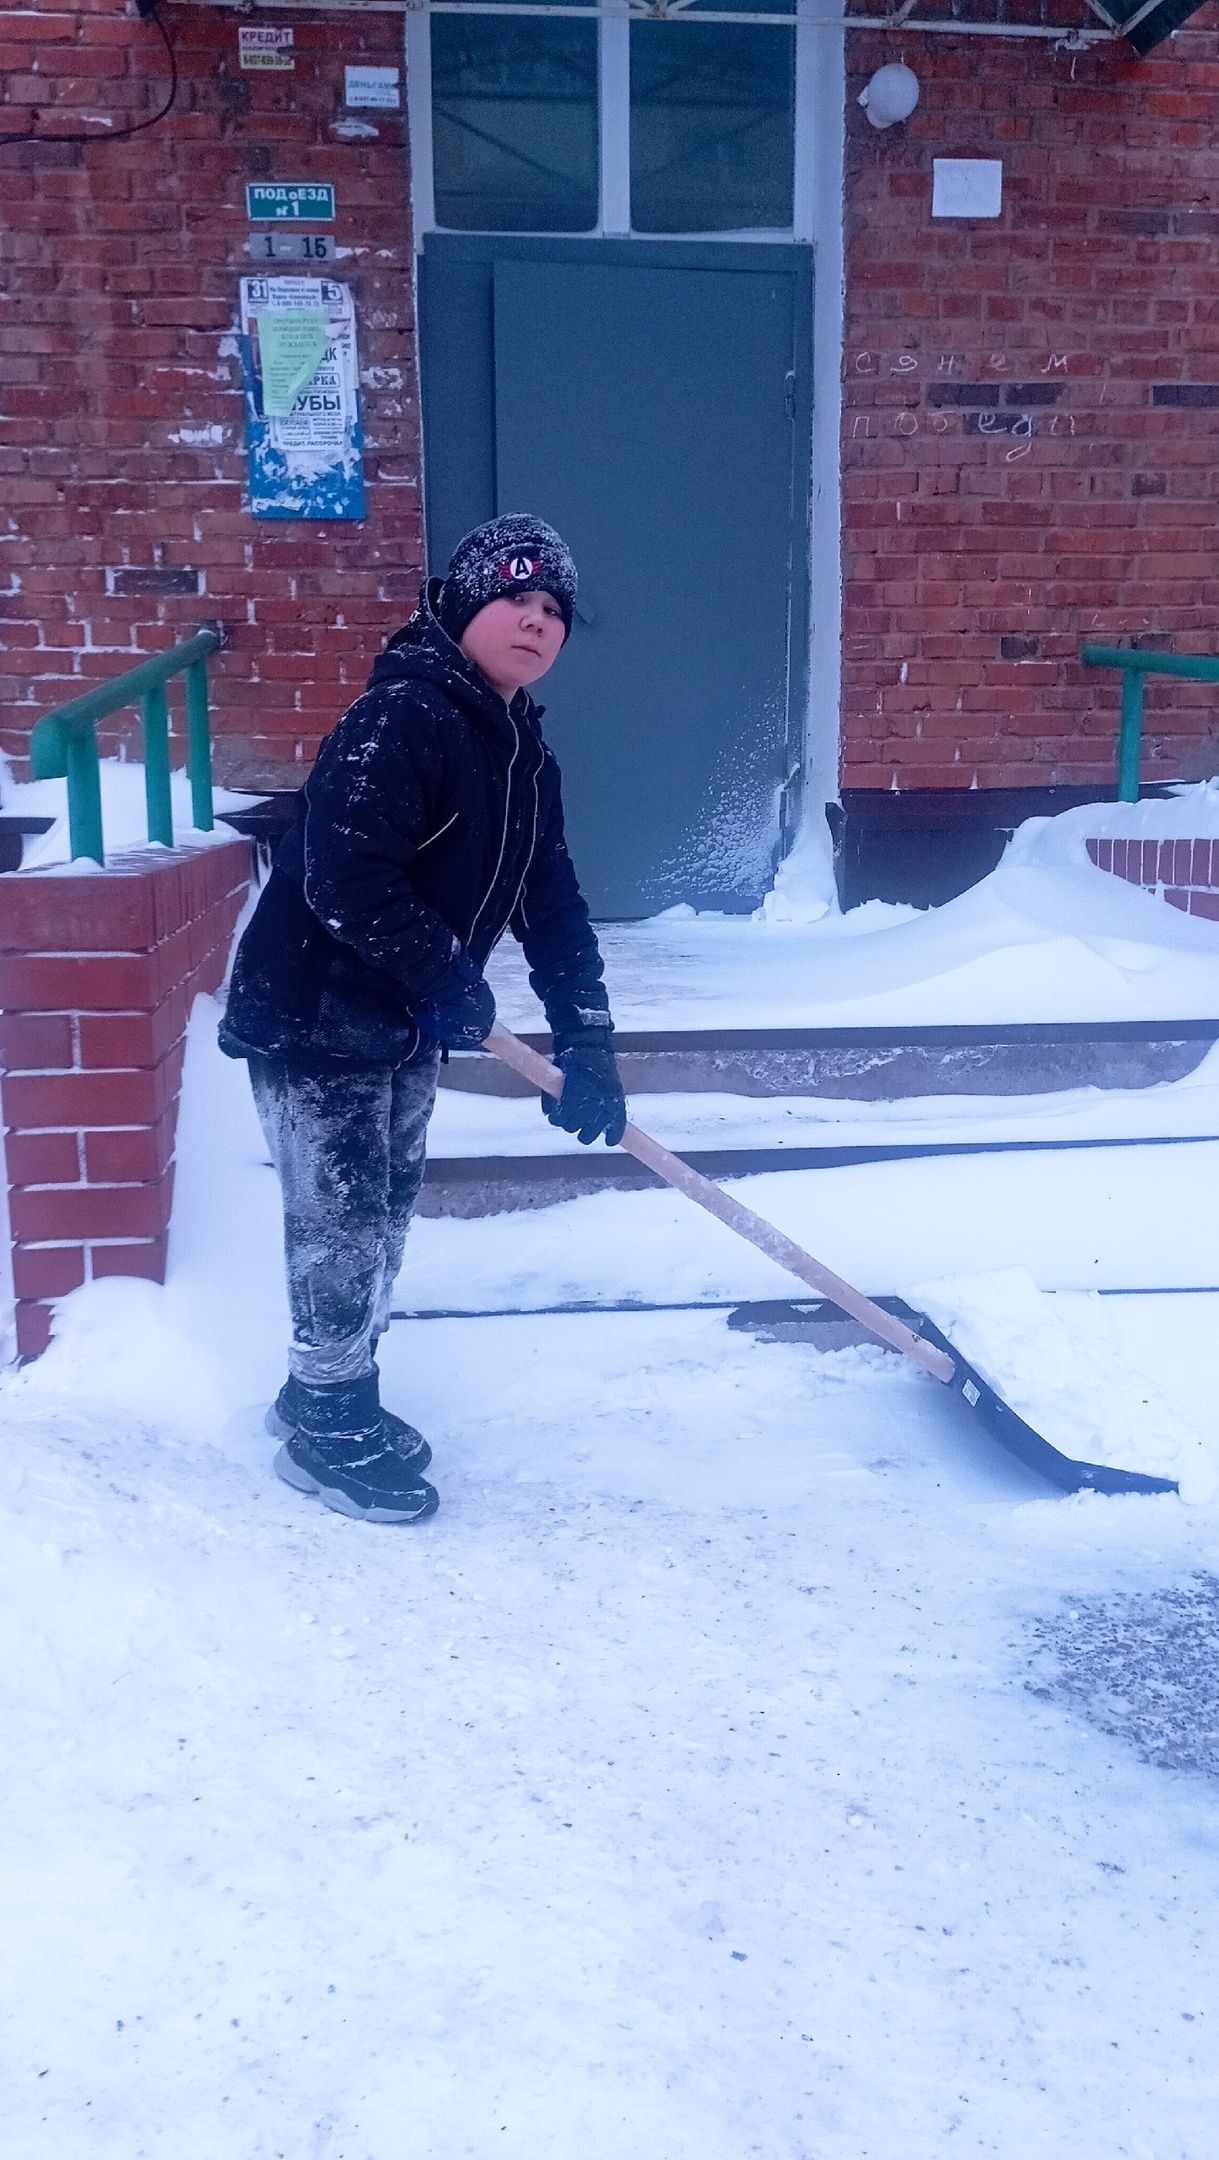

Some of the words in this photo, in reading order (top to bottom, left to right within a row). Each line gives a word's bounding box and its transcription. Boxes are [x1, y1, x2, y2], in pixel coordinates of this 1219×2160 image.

[241, 31, 291, 43] КРЕДИТ
[264, 236, 276, 257] 1
[302, 236, 327, 258] 15
